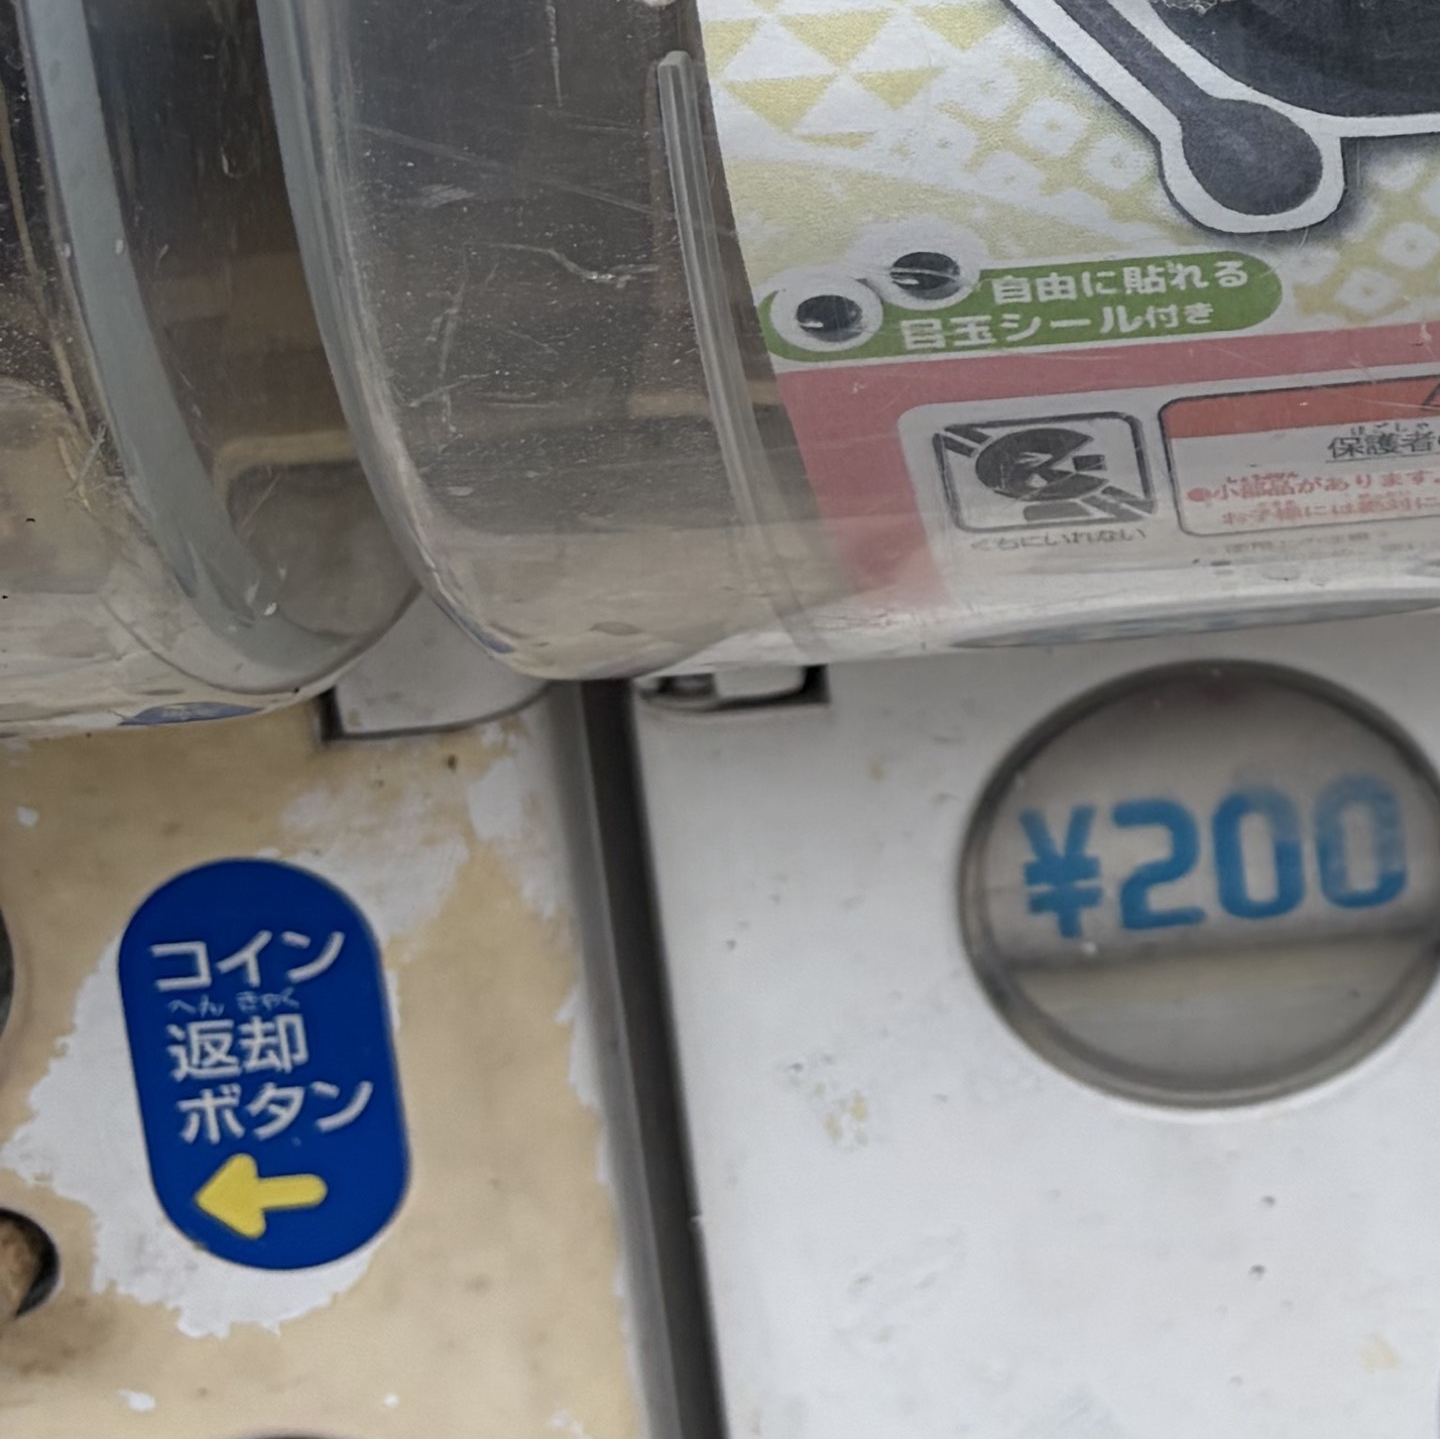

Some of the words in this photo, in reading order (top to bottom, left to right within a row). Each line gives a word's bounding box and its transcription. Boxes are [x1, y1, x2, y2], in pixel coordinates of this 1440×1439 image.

[992, 258, 1250, 306] 自由に貼れる
[901, 301, 1215, 352] 目玉シール付き
[1018, 773, 1410, 939] ¥200
[150, 929, 346, 991] コイン
[166, 1013, 309, 1083] 返却
[176, 1080, 374, 1145] ボタン
